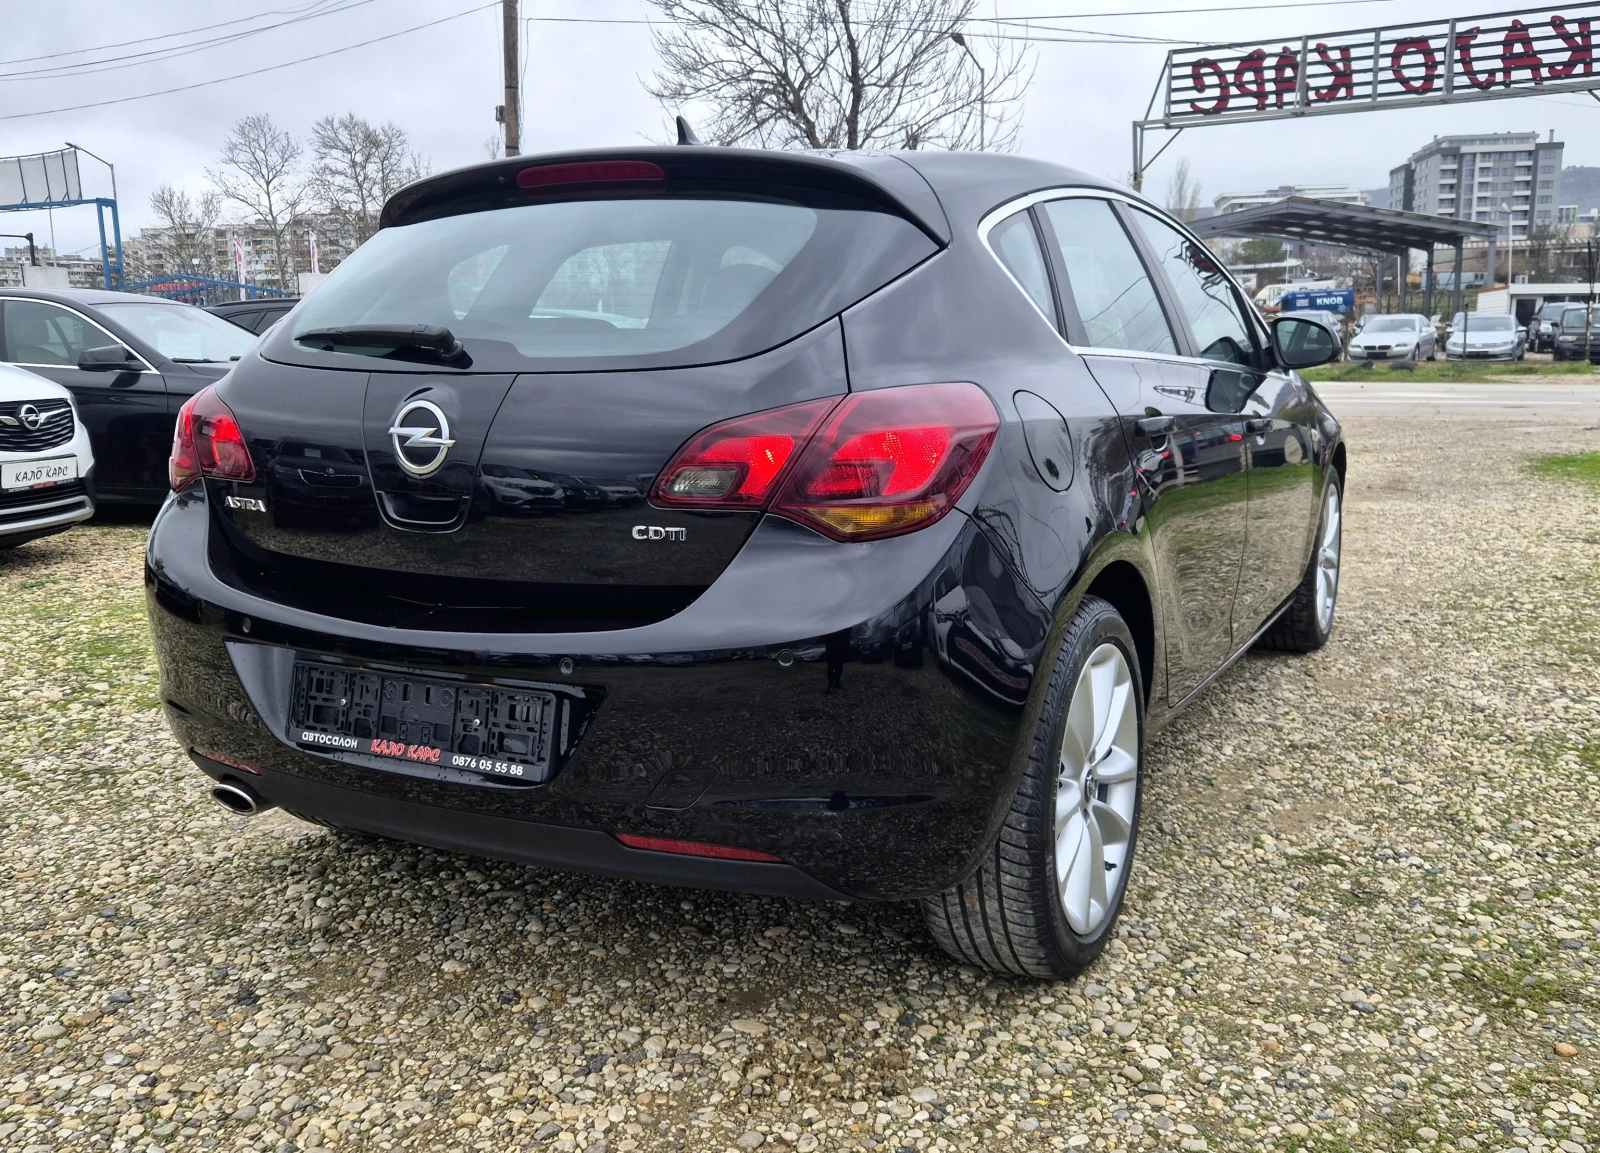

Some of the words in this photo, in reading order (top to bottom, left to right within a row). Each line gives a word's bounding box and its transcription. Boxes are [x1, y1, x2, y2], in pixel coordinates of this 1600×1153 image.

[1317, 297, 1343, 305] KNOB
[15, 469, 43, 482] КАЛО
[46, 466, 68, 478] КАРС
[224, 495, 267, 512] ASTRA
[632, 525, 687, 541] CDTI
[370, 739, 405, 757] КАЛО
[407, 745, 441, 763] КАРС
[452, 755, 477, 768] 0876
[479, 759, 492, 771] 05
[494, 762, 508, 773] 55
[509, 764, 524, 776] 88
